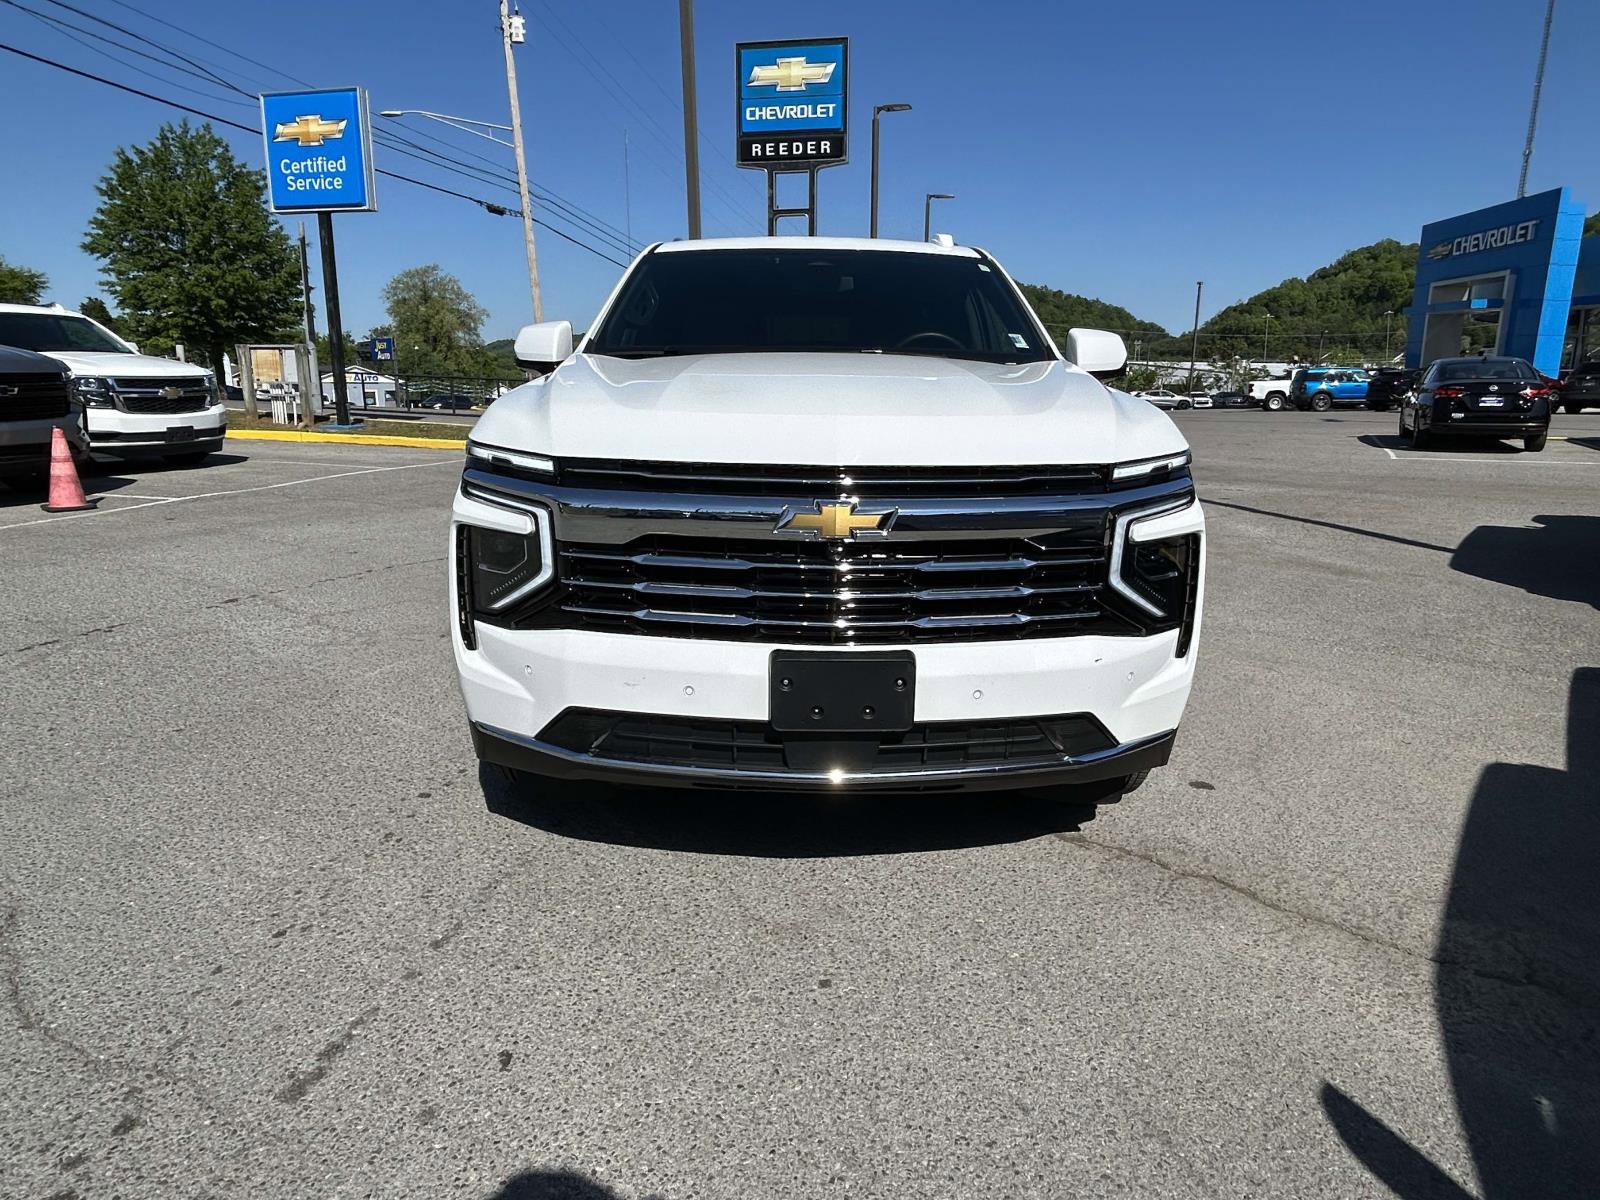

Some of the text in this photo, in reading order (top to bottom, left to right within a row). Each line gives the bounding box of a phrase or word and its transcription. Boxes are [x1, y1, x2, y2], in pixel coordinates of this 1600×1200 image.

[746, 104, 836, 121] CHEVROLET
[752, 141, 831, 157] REEDER
[280, 156, 347, 175] Certified
[287, 175, 343, 191] Service
[1452, 220, 1539, 256] CHEVROLET
